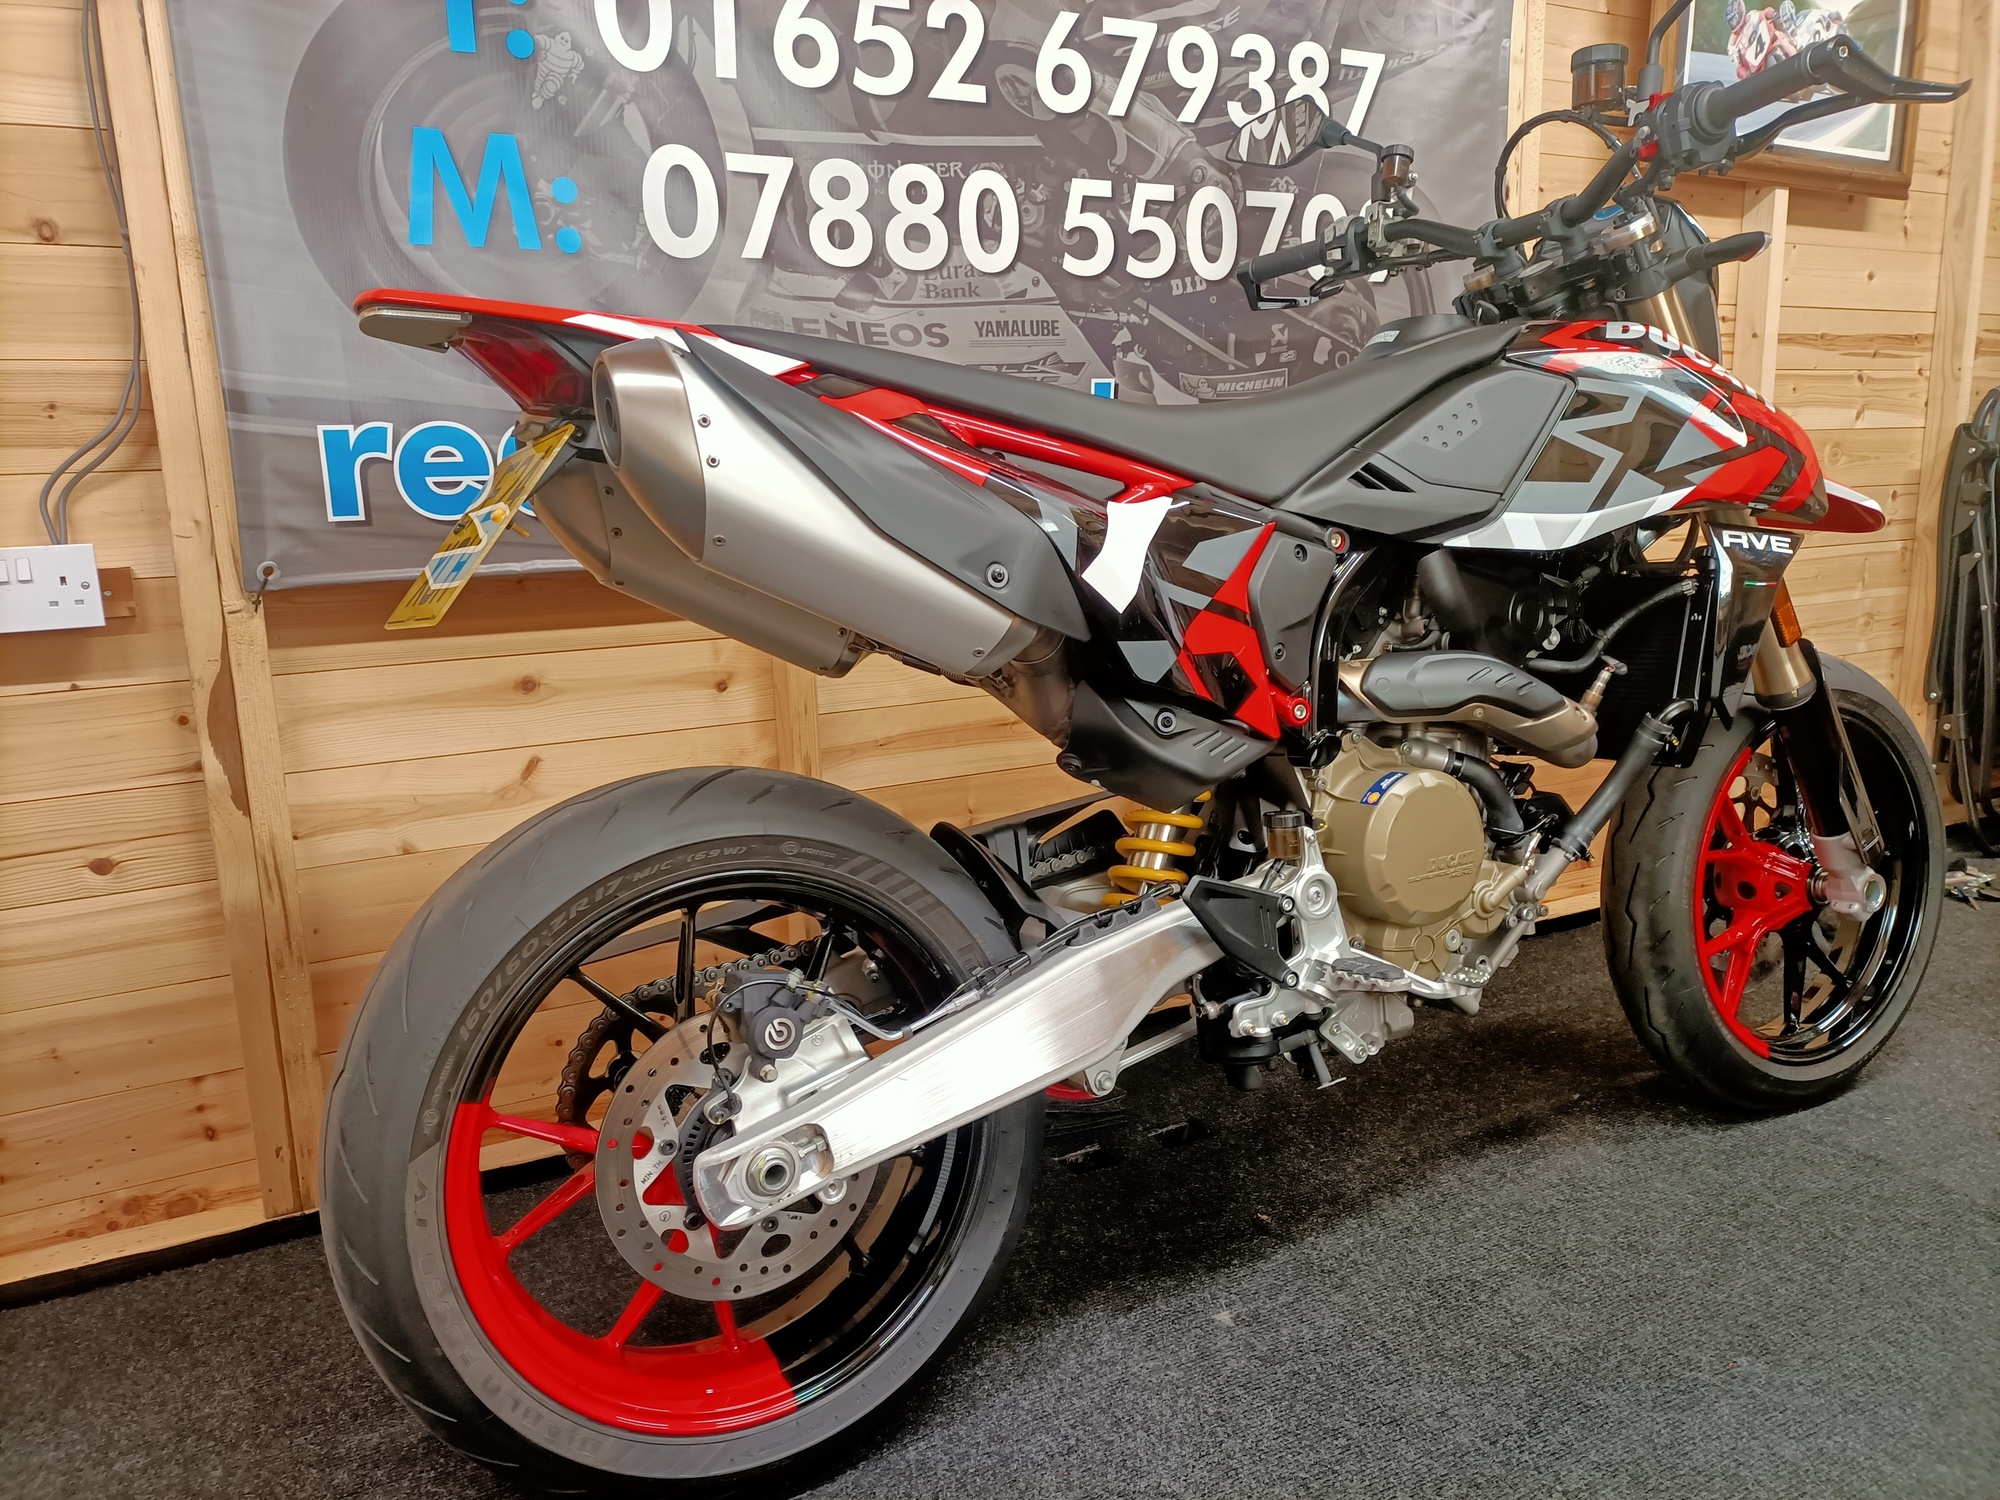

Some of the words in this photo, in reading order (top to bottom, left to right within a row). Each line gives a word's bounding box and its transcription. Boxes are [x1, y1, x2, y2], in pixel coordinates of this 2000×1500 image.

[593, 0, 988, 104] 01652
[1035, 11, 1386, 137] 679387
[408, 126, 582, 254] M:
[641, 143, 1020, 275] 07880
[1062, 177, 1396, 283] 55070
[924, 281, 981, 299] Bank
[791, 316, 950, 348] ENEOS
[974, 319, 1060, 338] YAMALUBE
[1216, 376, 1285, 392] MICHELIN
[1721, 530, 1794, 554] RVE
